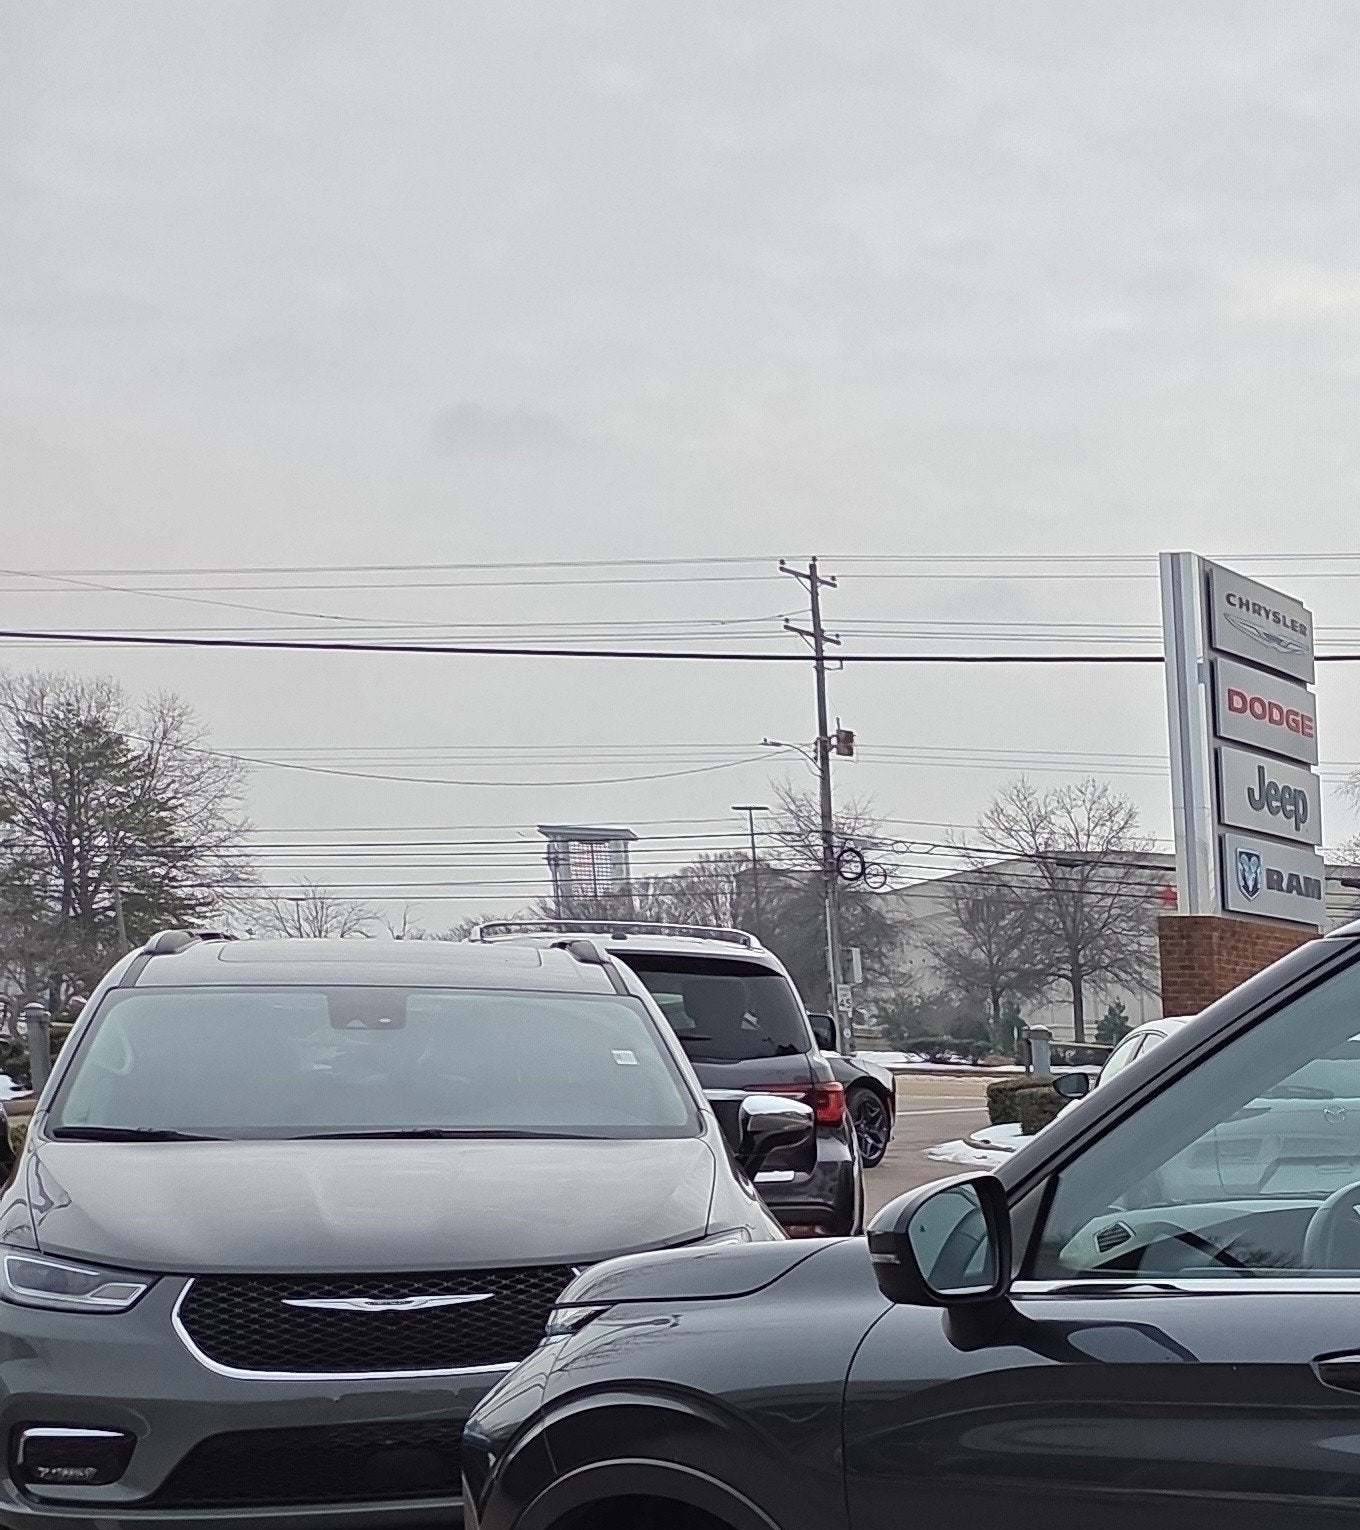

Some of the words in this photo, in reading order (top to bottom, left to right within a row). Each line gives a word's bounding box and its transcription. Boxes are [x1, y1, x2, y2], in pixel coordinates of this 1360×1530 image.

[1225, 593, 1307, 636] CHRYSLER
[1227, 688, 1314, 739] DODGE
[1247, 765, 1308, 832] Jeep
[1266, 868, 1322, 901] RAM
